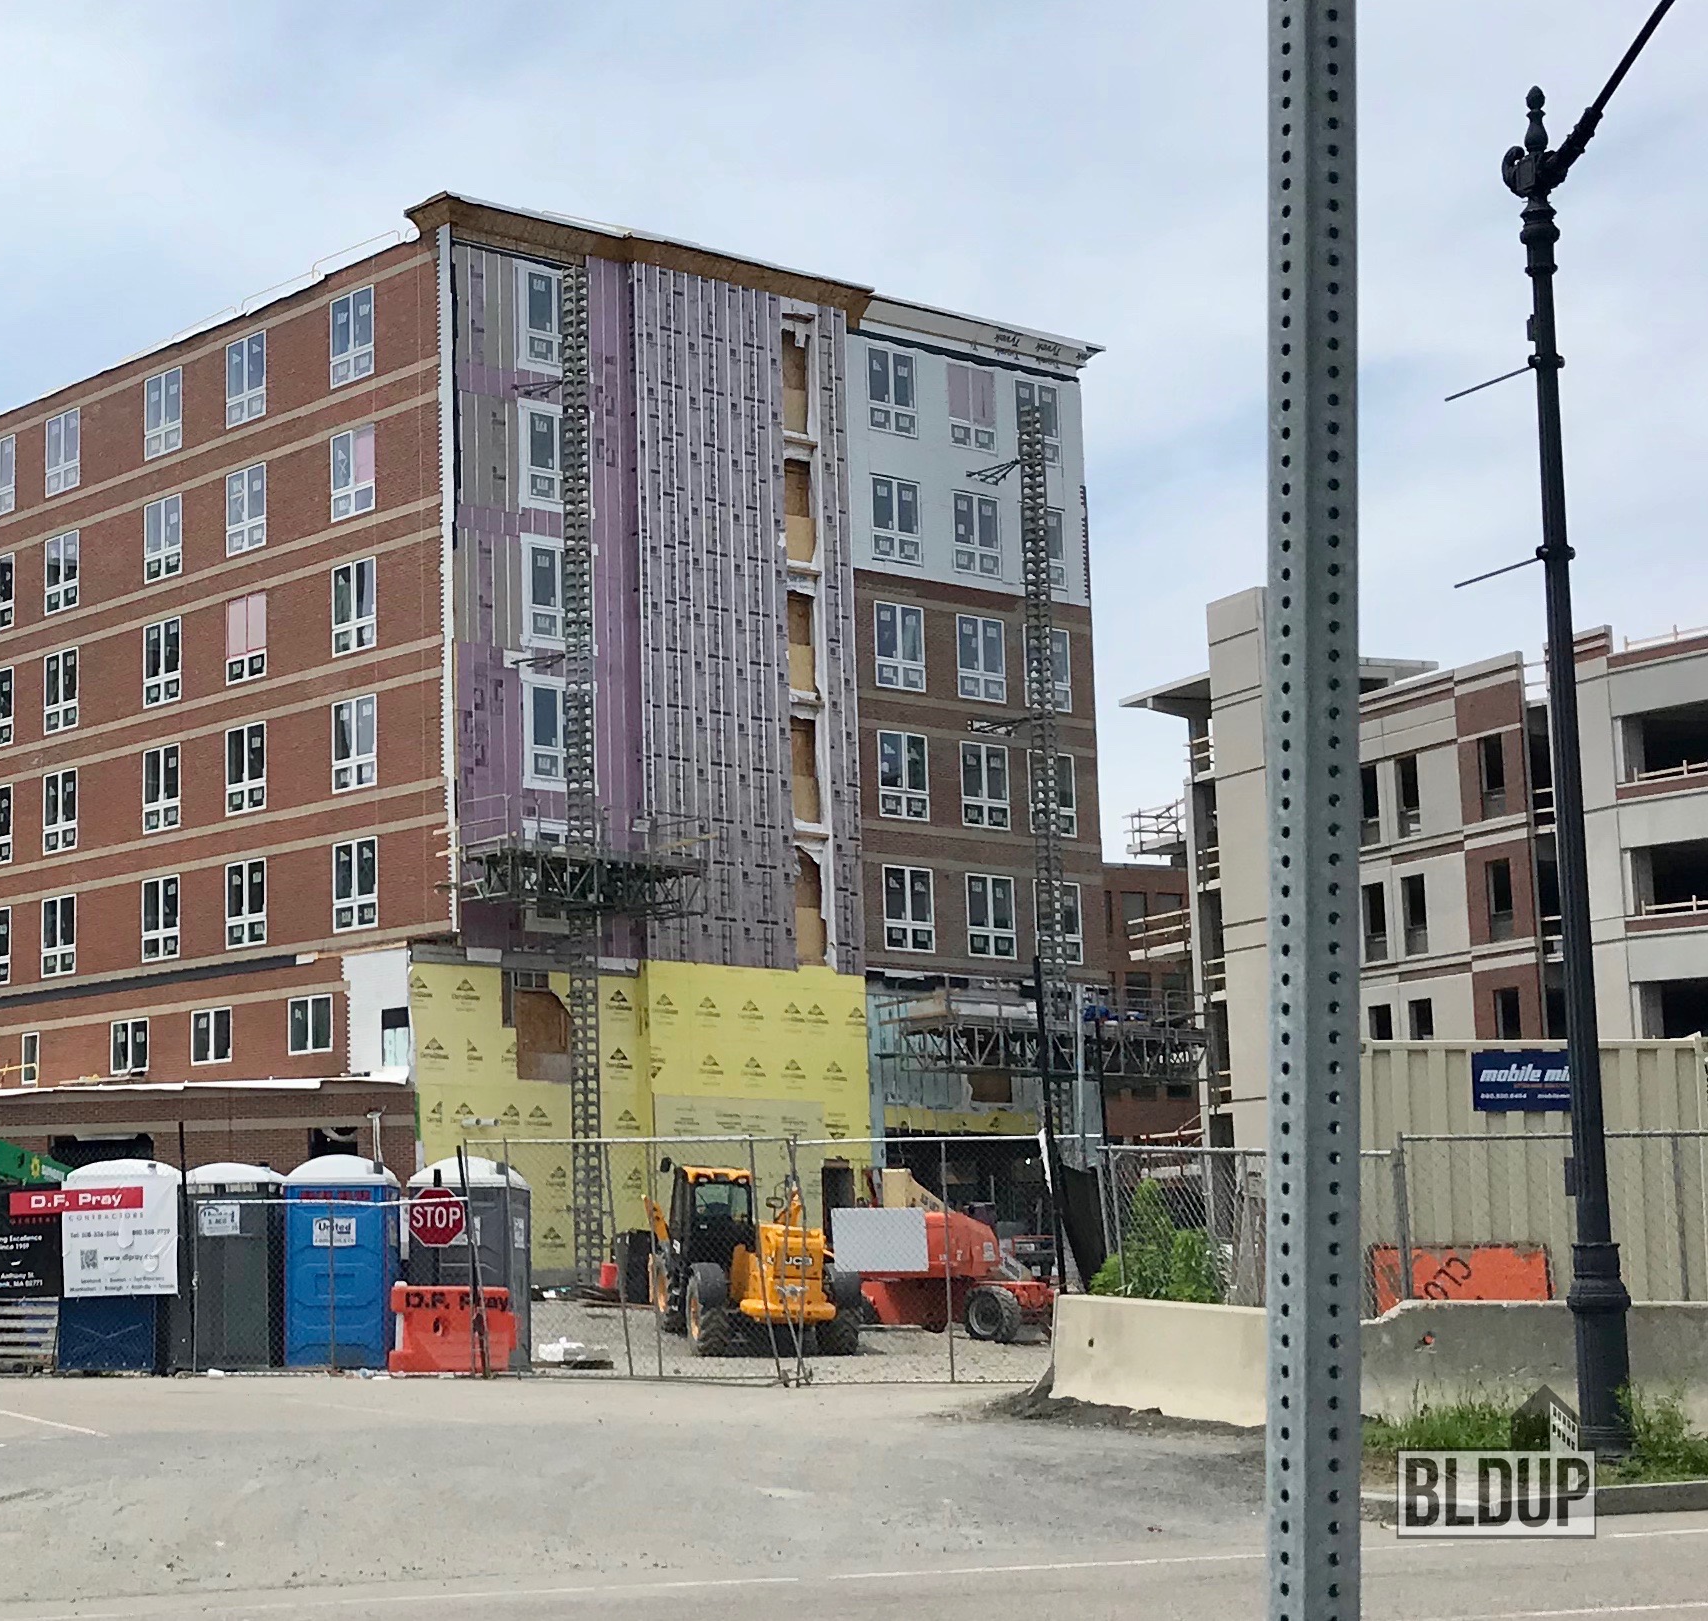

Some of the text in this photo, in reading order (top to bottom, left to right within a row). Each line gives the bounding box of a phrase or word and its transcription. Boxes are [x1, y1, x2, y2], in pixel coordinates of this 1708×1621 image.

[1479, 1063, 1542, 1082] mobile
[30, 1192, 122, 1209] D.F. Pray
[412, 1206, 461, 1229] STOP
[459, 1291, 508, 1312] Pay
